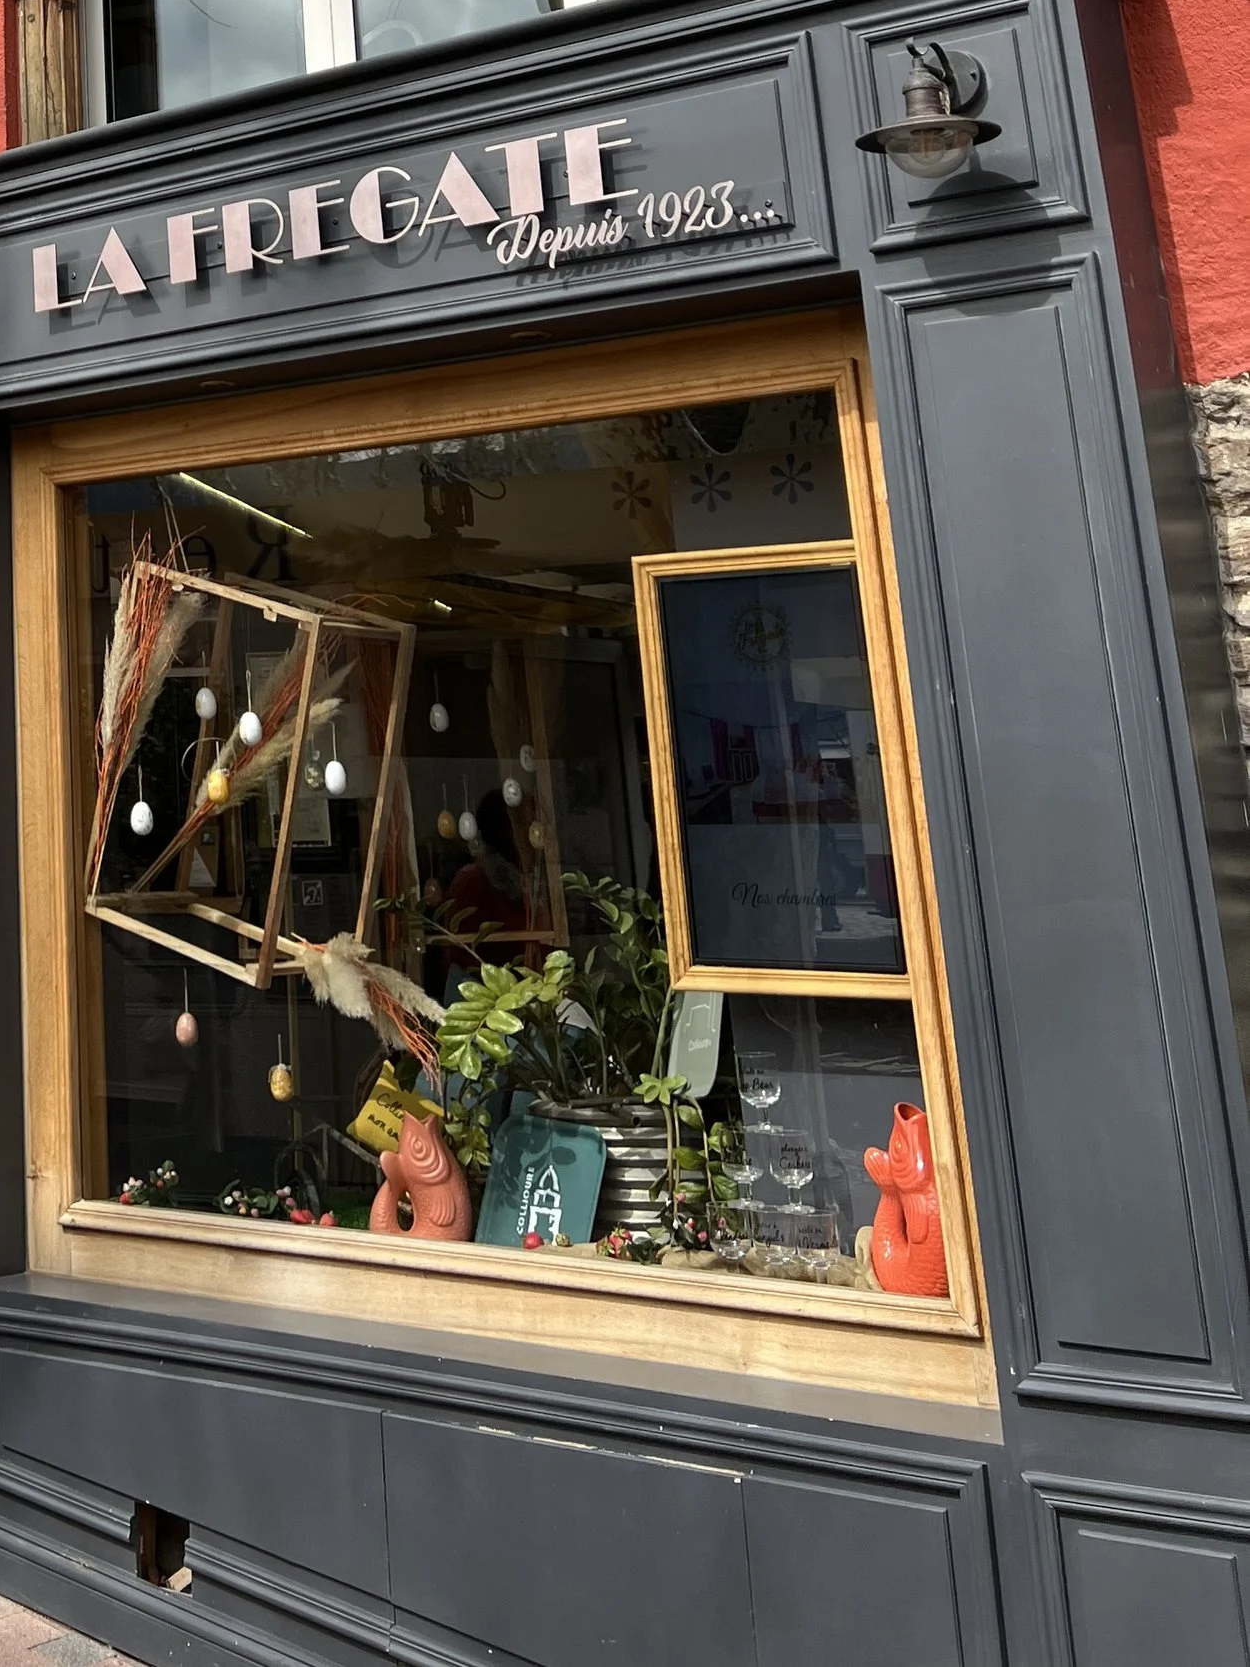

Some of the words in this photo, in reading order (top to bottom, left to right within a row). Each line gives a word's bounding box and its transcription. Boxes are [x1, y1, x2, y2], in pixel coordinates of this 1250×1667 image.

[32, 226, 146, 314] LA
[166, 117, 642, 284] FREGATE
[486, 208, 629, 269] Depuis
[731, 882, 770, 909] Nos
[516, 1166, 536, 1235] COLLIOURE
